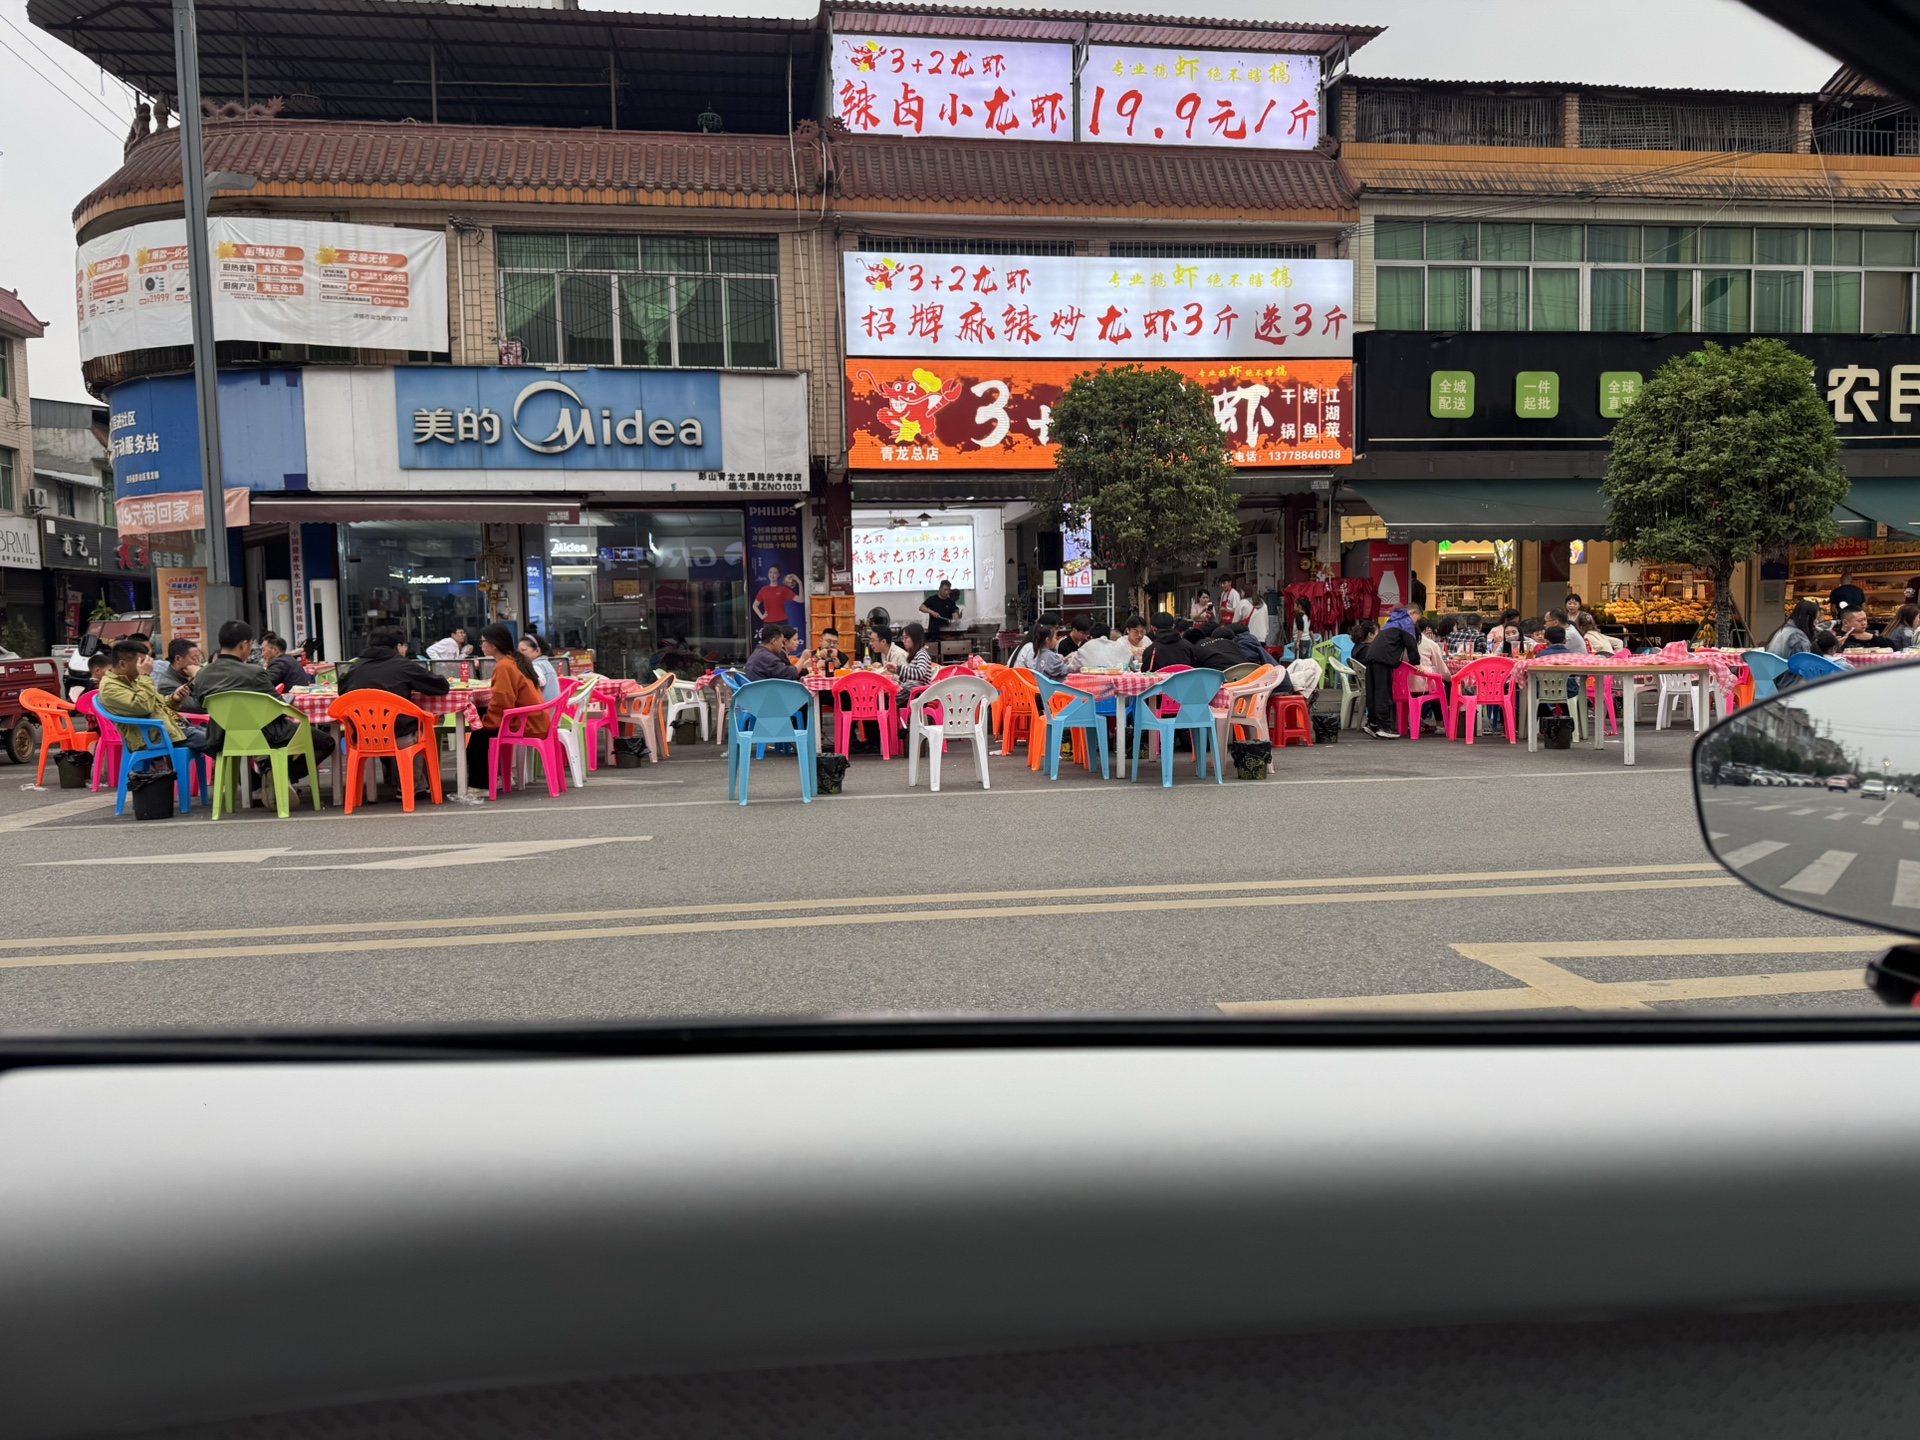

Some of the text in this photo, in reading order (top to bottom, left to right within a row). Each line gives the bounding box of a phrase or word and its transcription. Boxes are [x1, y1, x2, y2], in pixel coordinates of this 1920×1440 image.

[889, 48, 1007, 79] 3+2龙虾
[1111, 56, 1291, 85] 专业搞虾绝不瞎搞
[839, 80, 1067, 136] 辣卤小龙虾
[1088, 86, 1316, 141] 19.9元/斤
[245, 247, 286, 258] 厨电特惠
[908, 265, 1032, 296] 3+2龙虾
[1107, 264, 1294, 289] 专业搞虾绝不瞎搞
[1438, 379, 1467, 394] 全城
[1523, 379, 1551, 394] 一件
[1608, 379, 1635, 394] 全球
[1303, 388, 1318, 438] 烤鱼
[1438, 396, 1466, 411] 配送
[1523, 396, 1551, 410] 起批
[413, 390, 702, 450] 美的 Midea
[1325, 388, 1341, 439] 江湖菜
[880, 446, 939, 461] 青龙总店
[749, 507, 797, 516] PHILIPS
[550, 540, 587, 553] Midea
